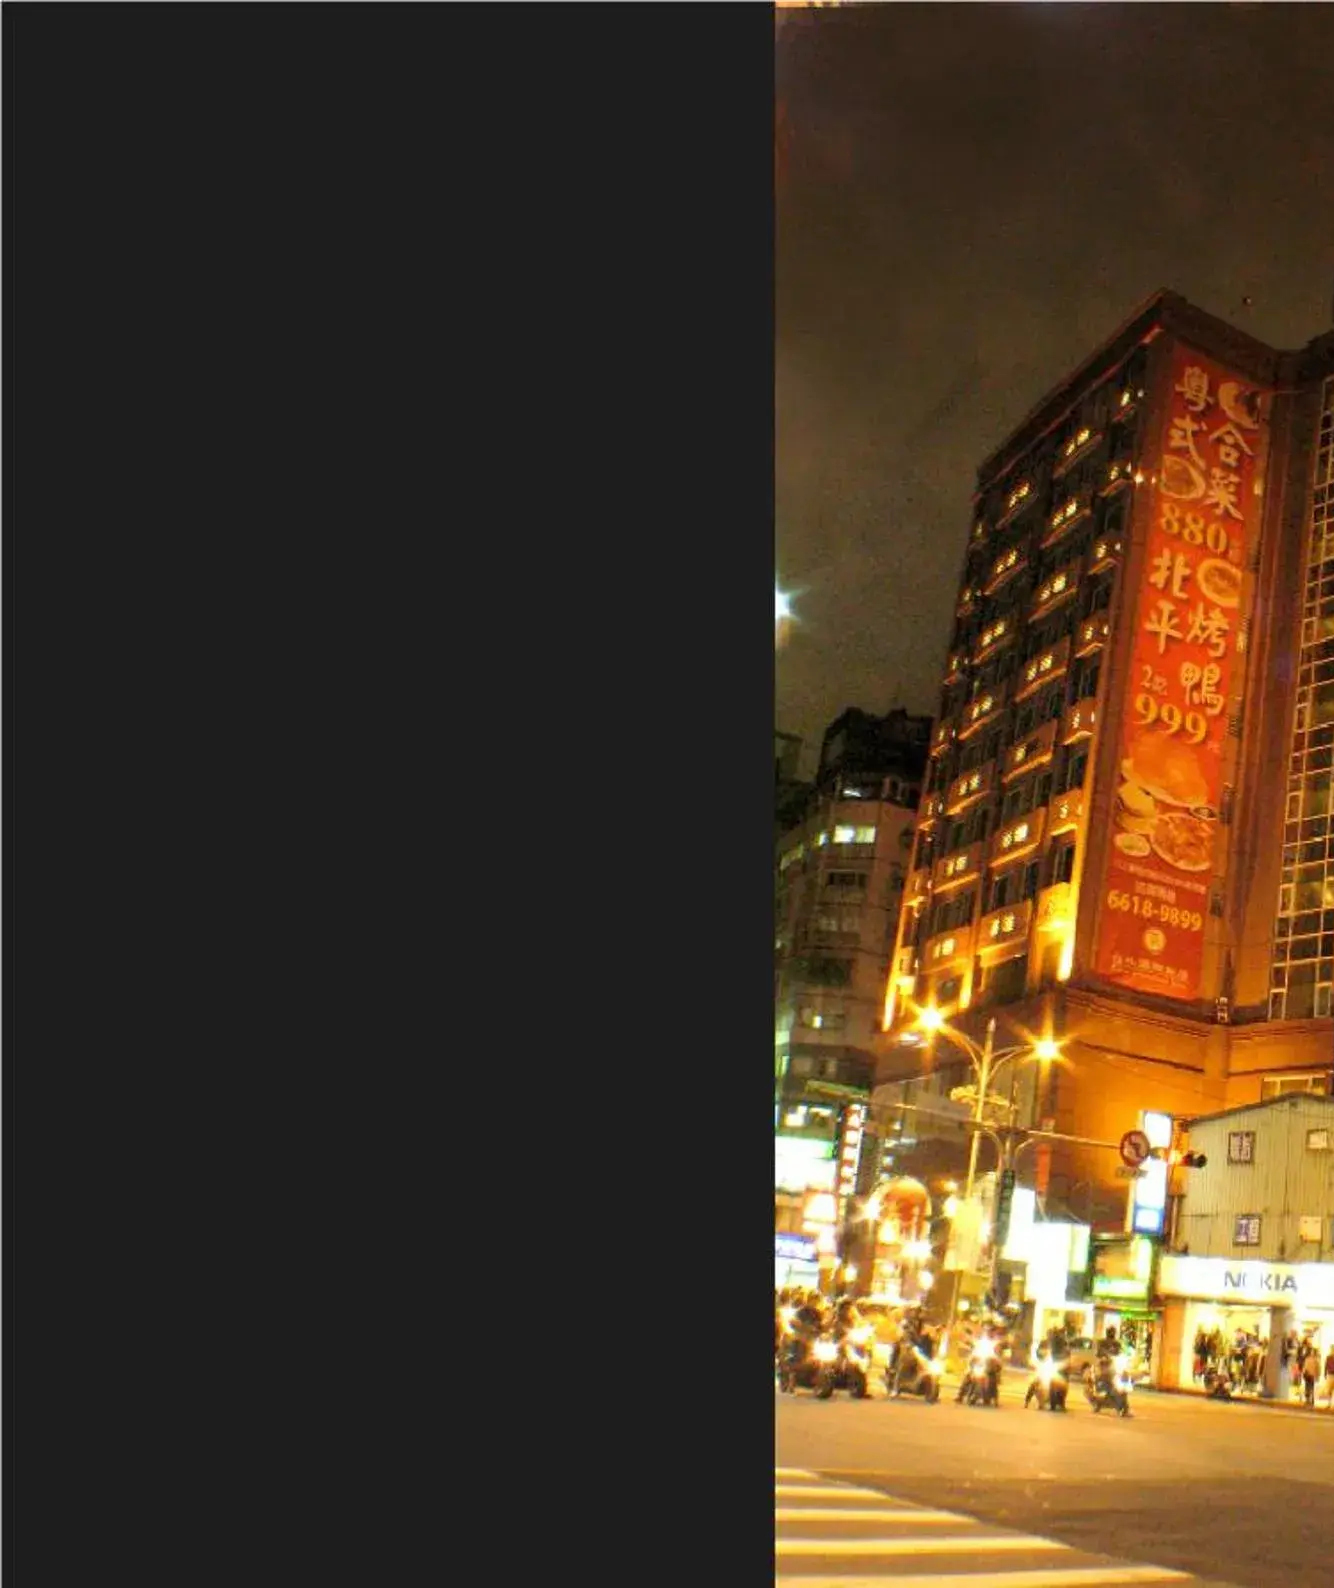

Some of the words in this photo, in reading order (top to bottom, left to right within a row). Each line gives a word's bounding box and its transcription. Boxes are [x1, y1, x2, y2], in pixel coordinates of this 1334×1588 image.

[1202, 421, 1254, 520] 合菜
[1160, 502, 1228, 554] 880
[1143, 547, 1192, 655] 北平
[1178, 602, 1230, 717] 烤鴨
[1133, 692, 1208, 744] 999
[1107, 889, 1203, 932] 6618-9899
[1224, 1270, 1298, 1294] NKIA
